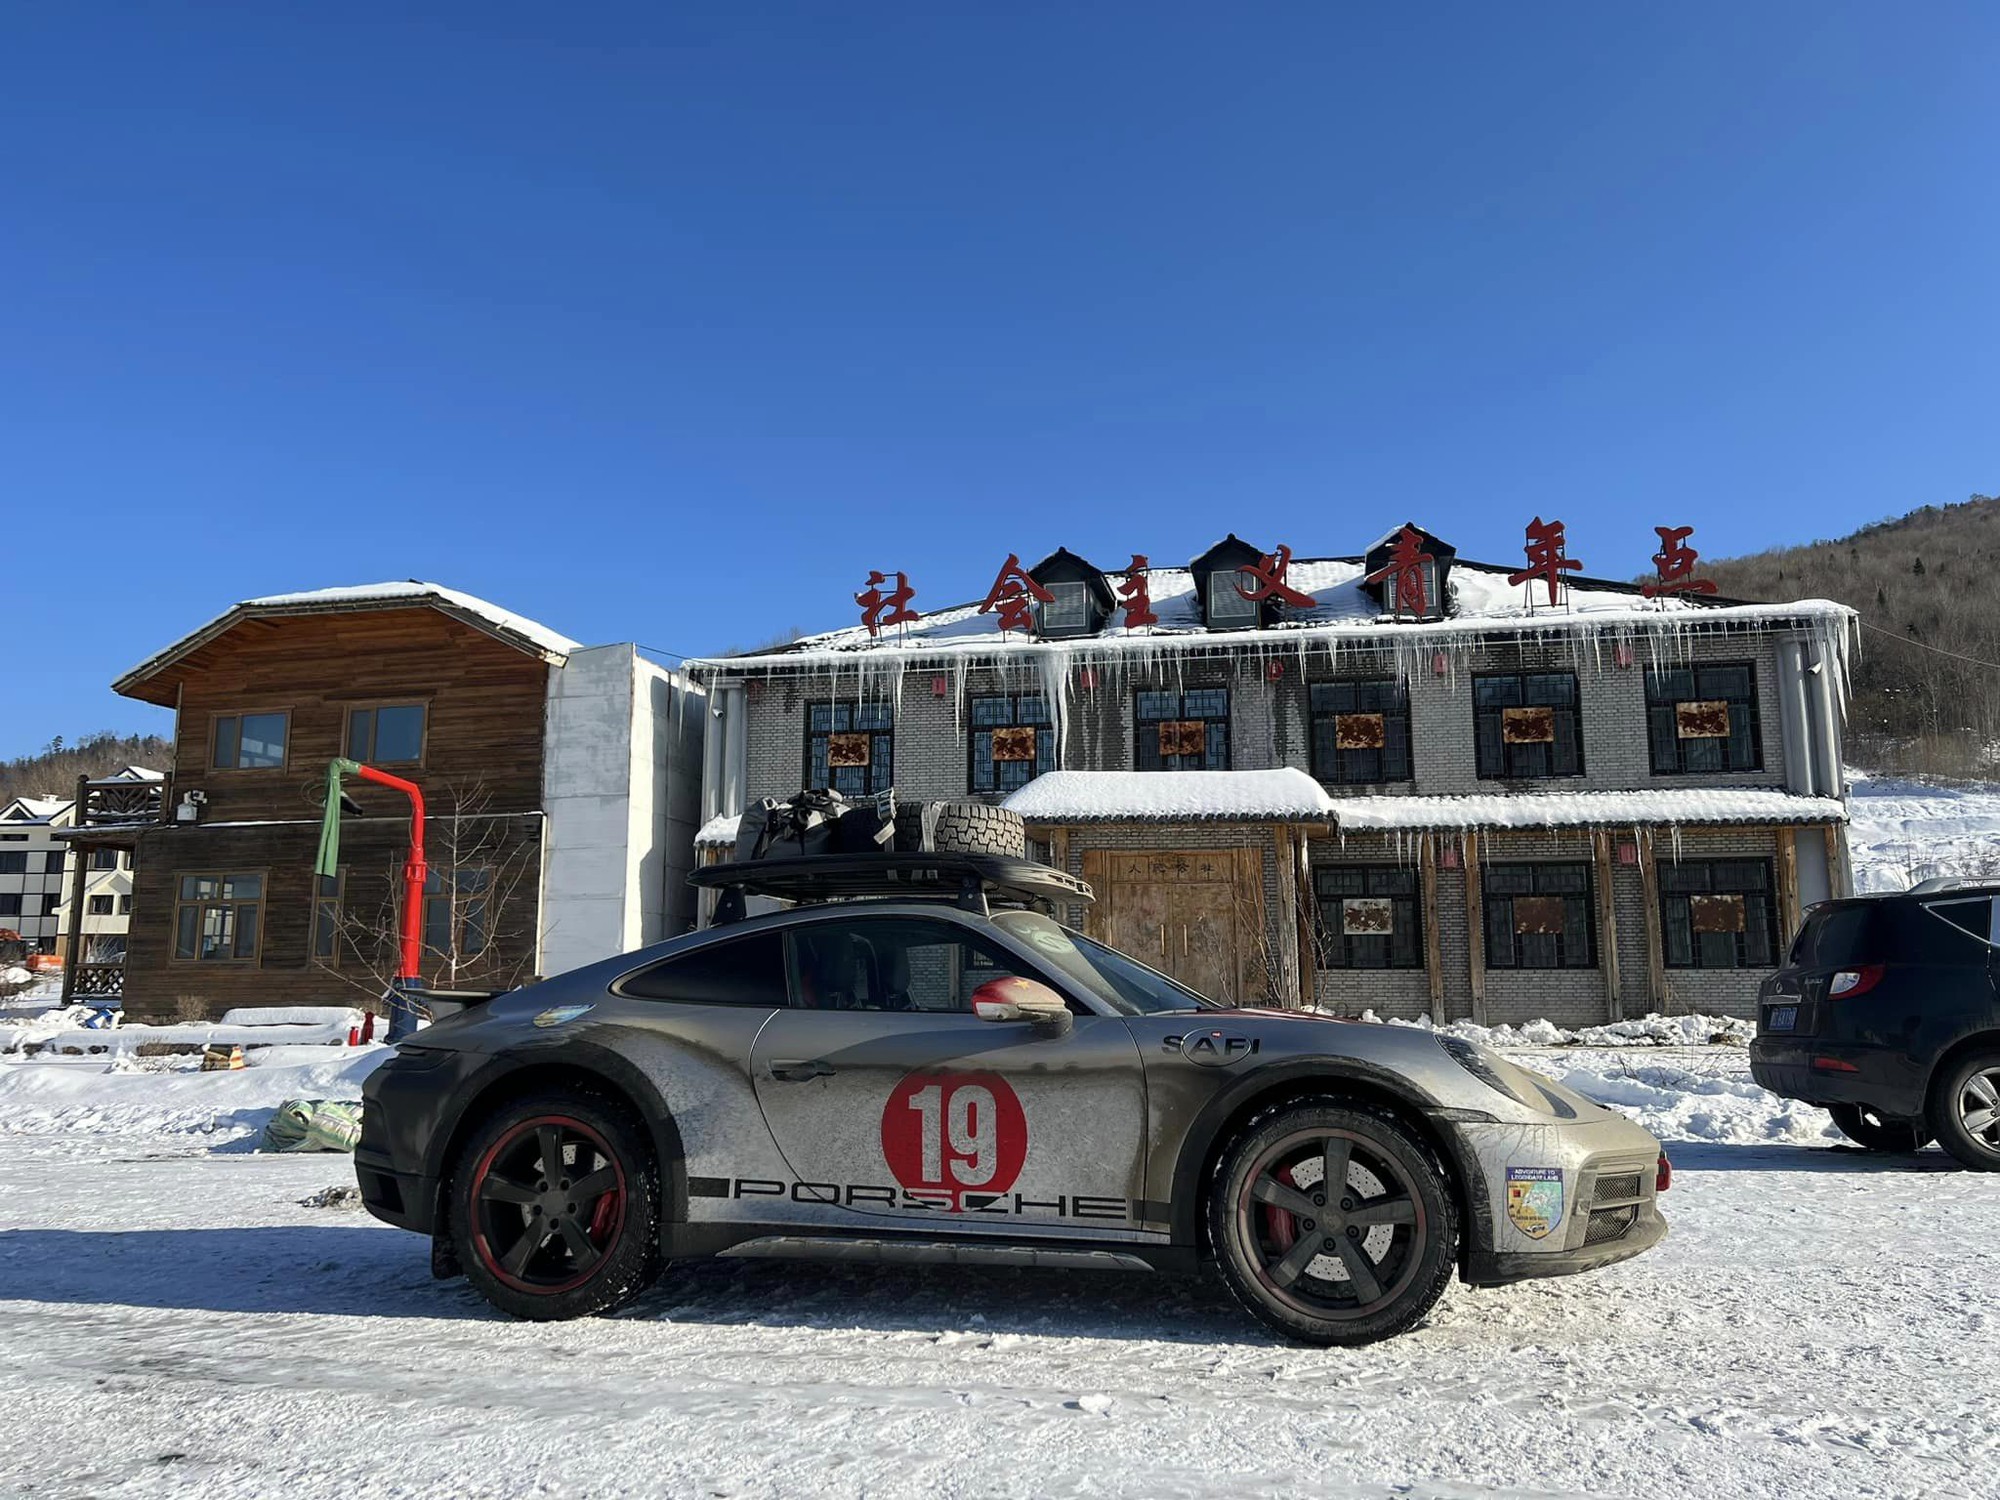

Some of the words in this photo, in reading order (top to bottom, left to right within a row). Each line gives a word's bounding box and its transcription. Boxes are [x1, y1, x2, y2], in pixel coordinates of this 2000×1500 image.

[854, 516, 1717, 637] 社会主义青年点
[909, 1084, 998, 1186] 19
[733, 1179, 1127, 1220] PORSCHE
